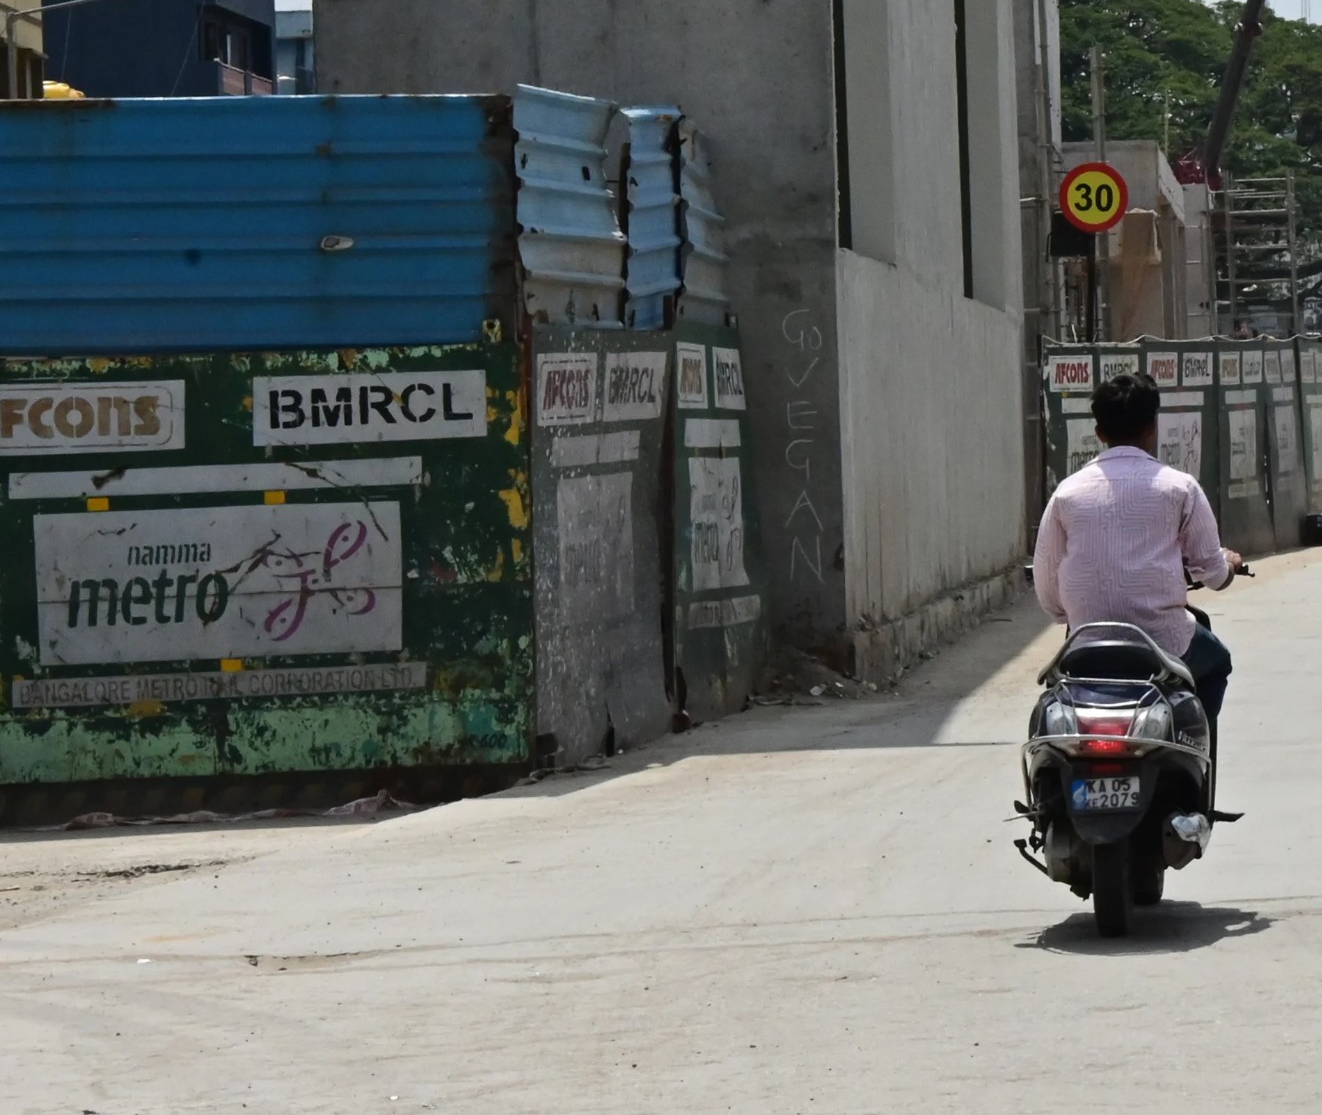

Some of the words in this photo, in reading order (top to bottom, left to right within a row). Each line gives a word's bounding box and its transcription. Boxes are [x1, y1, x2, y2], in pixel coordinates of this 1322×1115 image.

[1074, 183, 1114, 213] 30
[1054, 362, 1089, 384] AFCONS
[0, 396, 161, 439] FCONS
[269, 382, 474, 429] BMRCL
[127, 542, 211, 567] namma
[67, 569, 230, 629] metro
[20, 681, 131, 705] BANGALORE
[136, 676, 197, 701] METRO
[250, 668, 375, 695] CORPORATION
[1086, 780, 1107, 793] KA
[1112, 778, 1131, 792] 05
